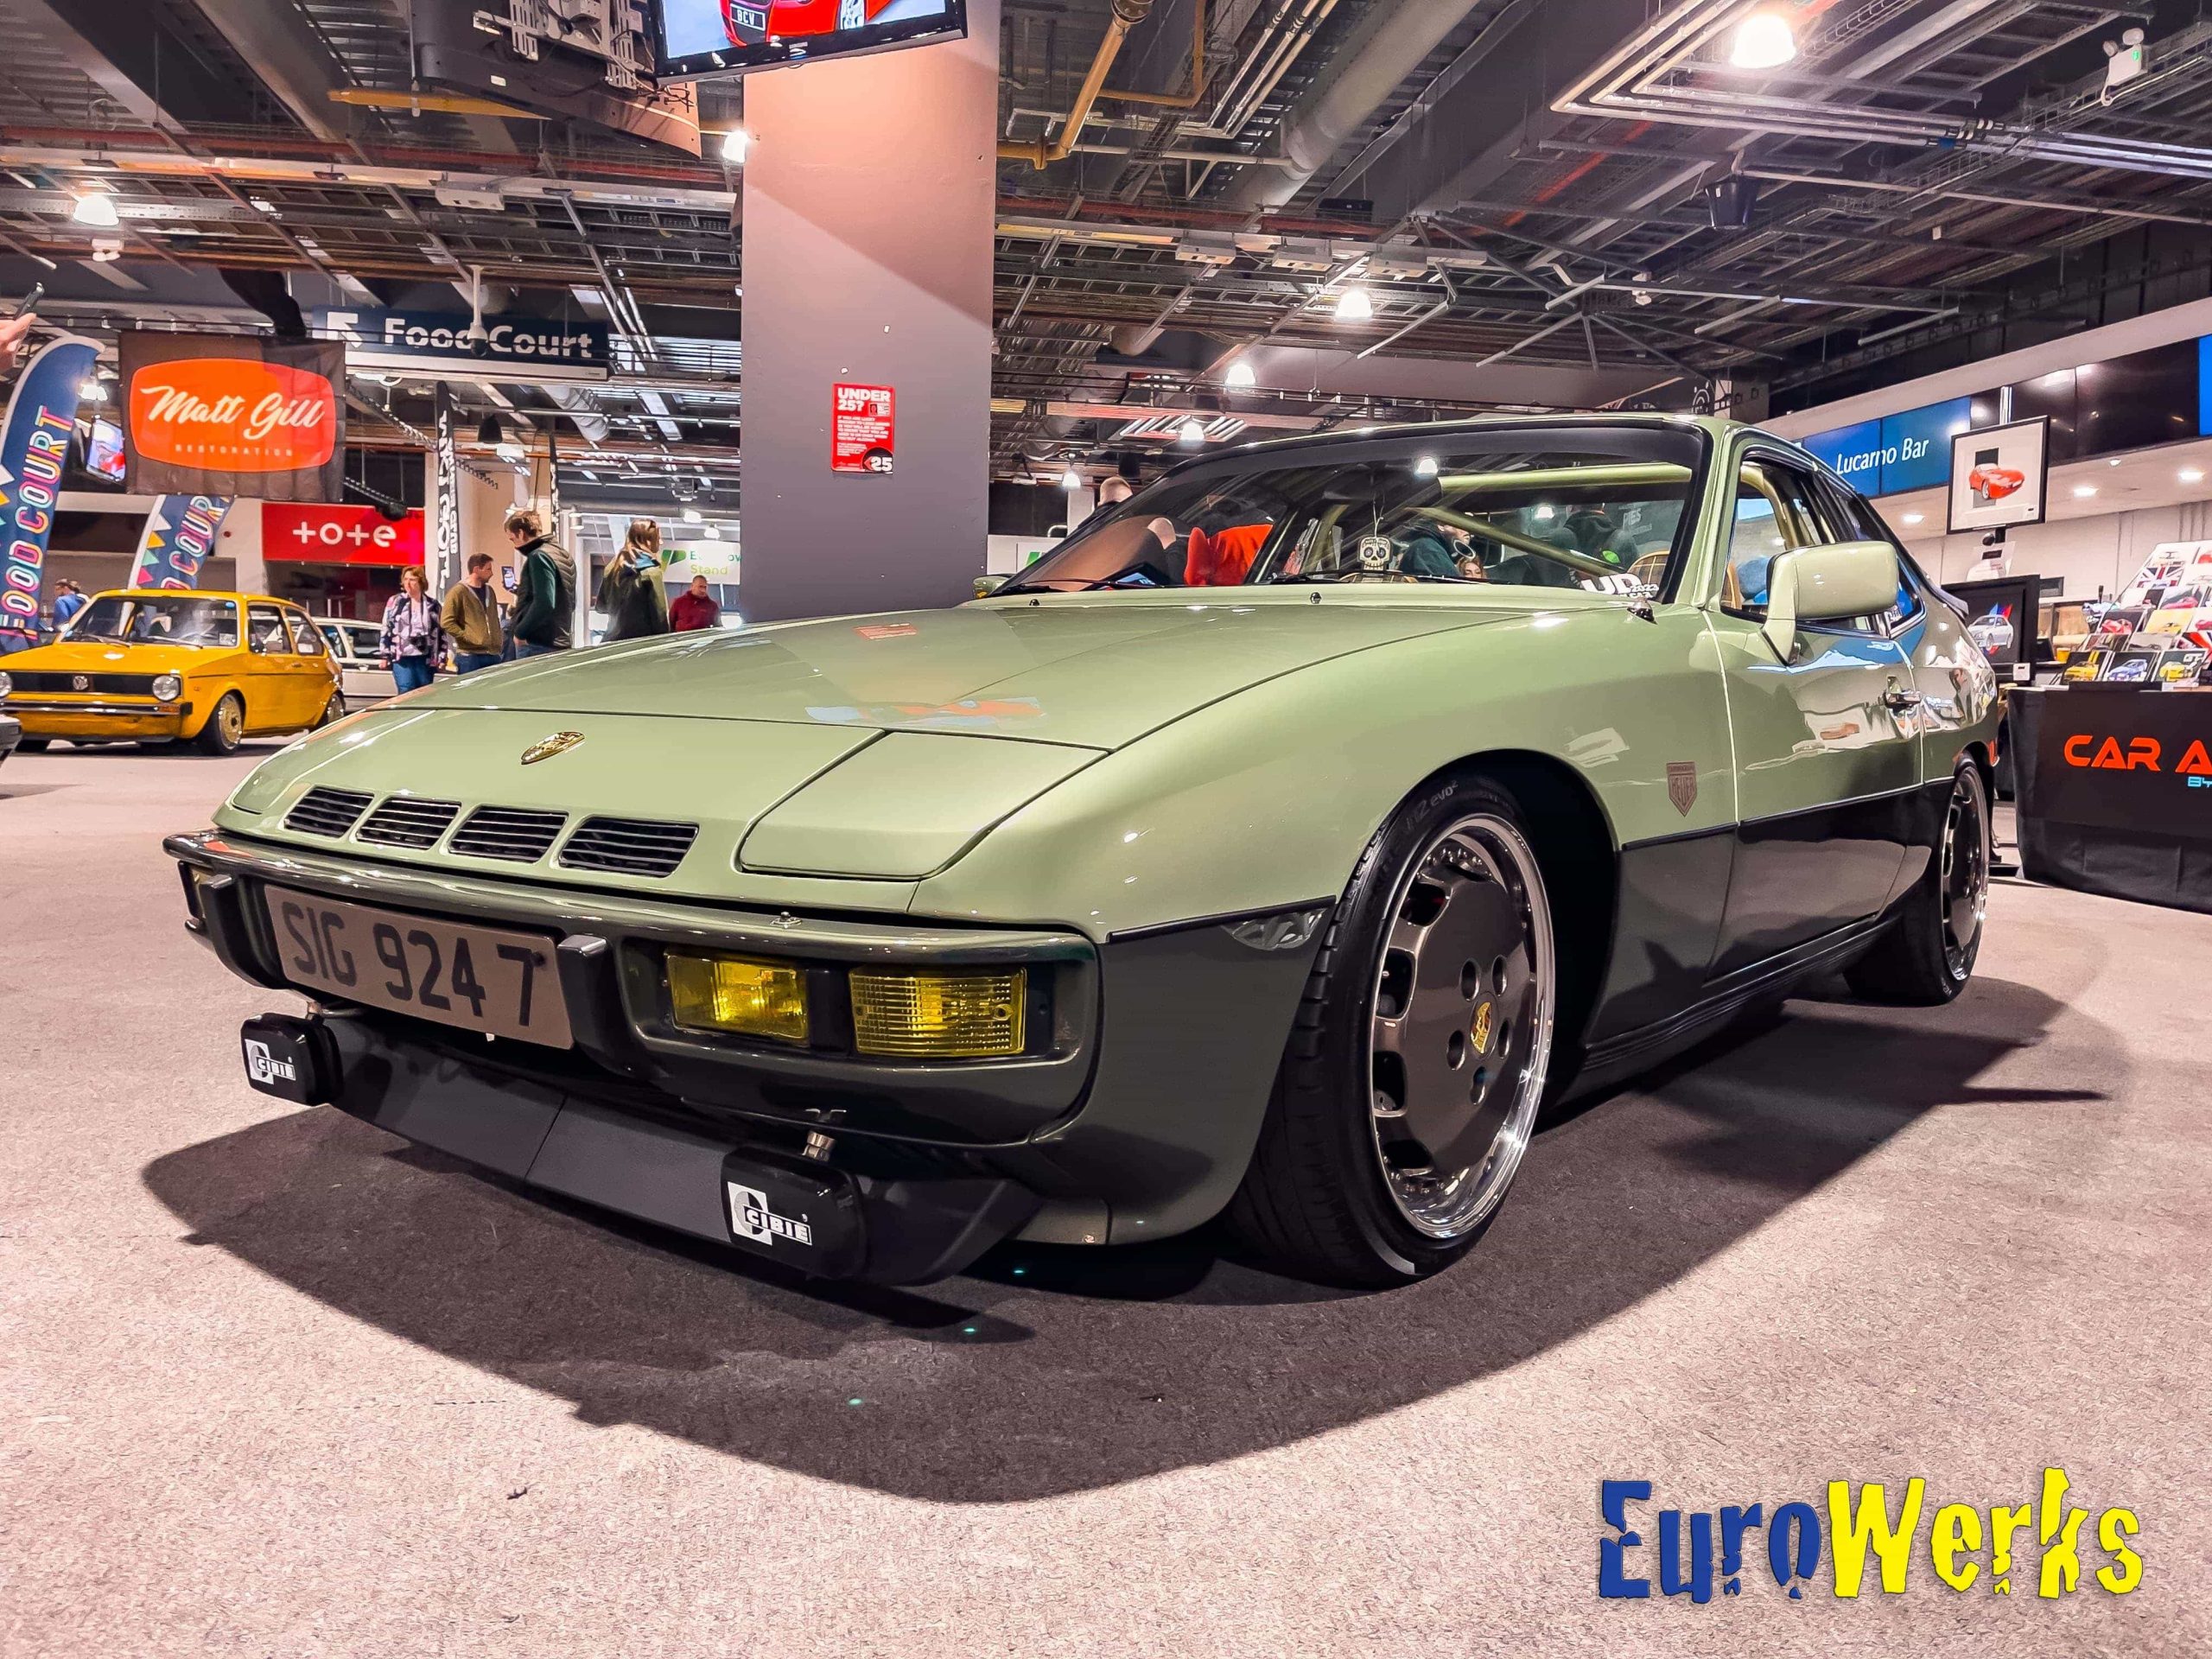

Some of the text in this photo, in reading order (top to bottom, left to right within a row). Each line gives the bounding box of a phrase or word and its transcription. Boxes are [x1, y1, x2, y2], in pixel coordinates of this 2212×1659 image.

[489, 326, 593, 358] Court
[837, 388, 891, 402] UNDER
[837, 399, 864, 411] 25?
[140, 385, 325, 440] Matt Gill
[175, 443, 293, 457] RESTORATION
[871, 456, 893, 471] 25
[1837, 437, 1929, 476] Lucarno Bar
[0, 405, 74, 640] FOOD COURT
[168, 496, 234, 576] COUR
[292, 521, 396, 548] tote
[690, 565, 728, 575] Stand
[1581, 574, 1642, 594] UD
[2063, 734, 2161, 772] CAR
[283, 901, 358, 988] SIG
